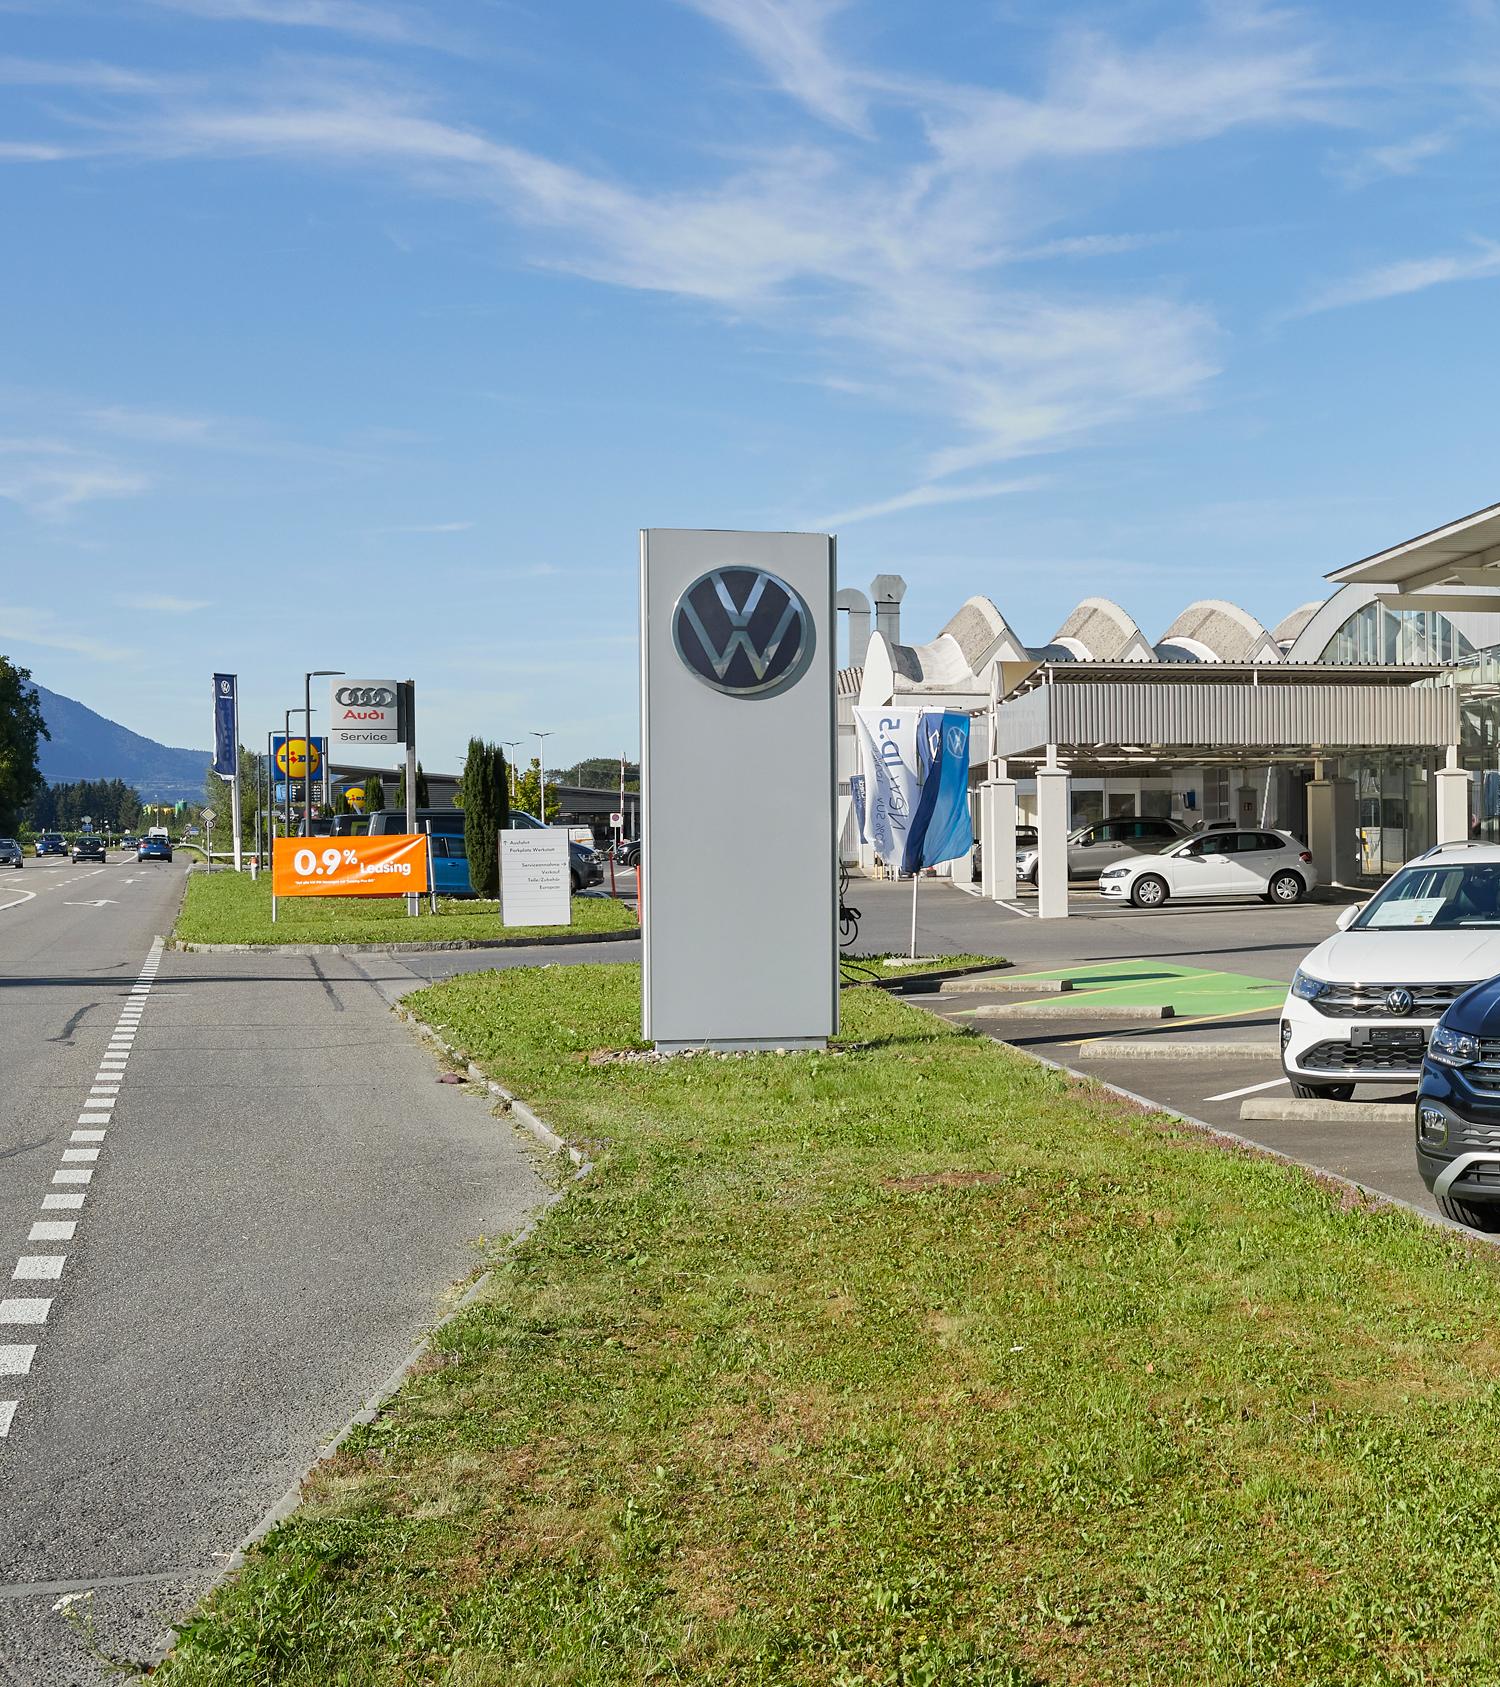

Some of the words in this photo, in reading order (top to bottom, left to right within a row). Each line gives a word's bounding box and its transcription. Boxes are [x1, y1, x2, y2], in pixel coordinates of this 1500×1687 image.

[343, 710, 385, 720] Audi
[340, 732, 388, 741] Service
[294, 848, 358, 877] 0.9%
[360, 860, 411, 876] Leasing
